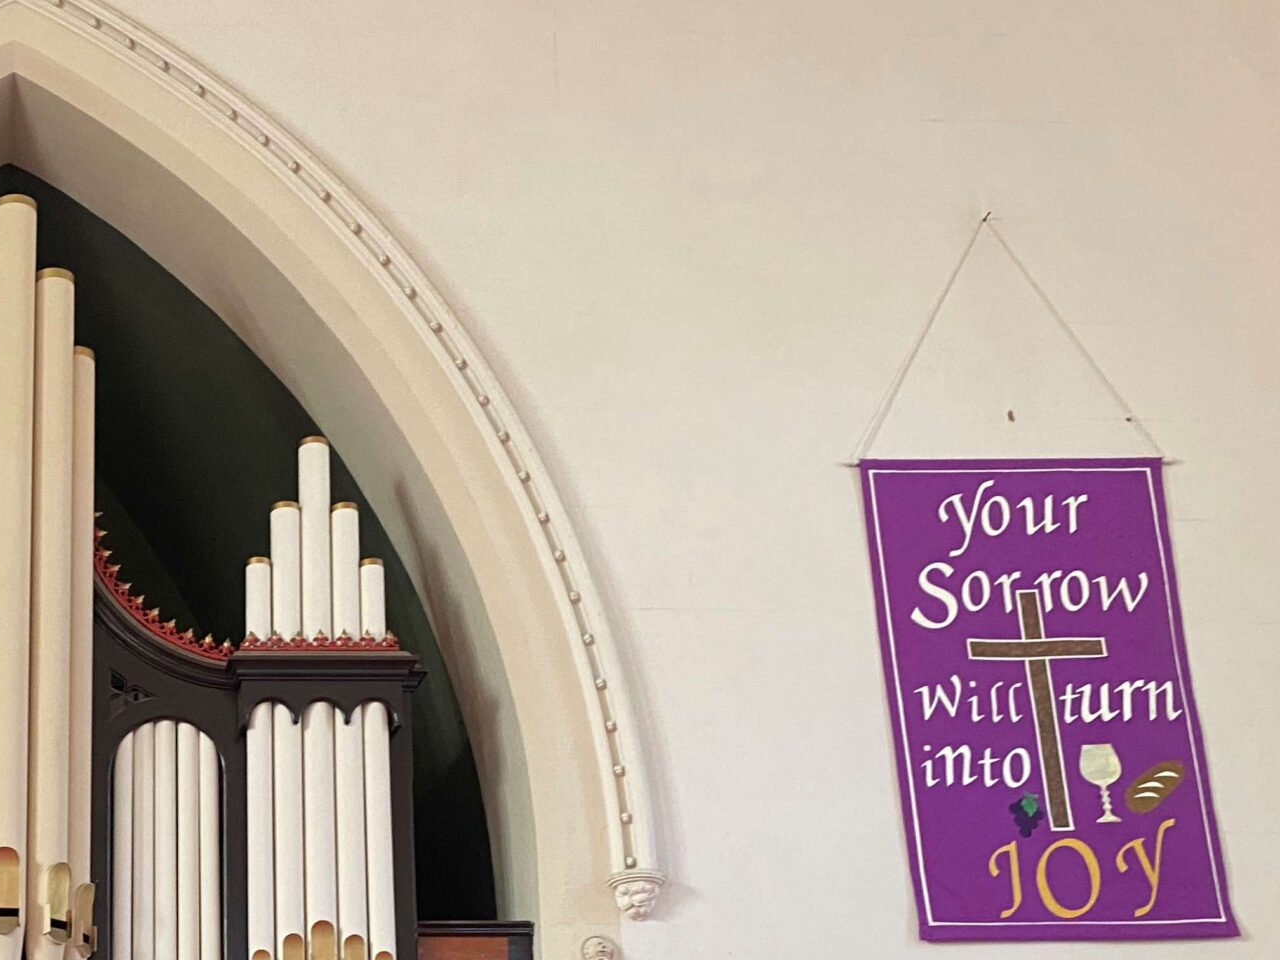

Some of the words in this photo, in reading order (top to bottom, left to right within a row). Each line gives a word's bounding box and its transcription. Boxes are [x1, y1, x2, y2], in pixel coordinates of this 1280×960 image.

[910, 561, 1149, 629] Sorrow
[914, 674, 1023, 723] will
[1058, 679, 1183, 724] turn
[920, 744, 1032, 789] into
[988, 818, 1175, 919] JOY
